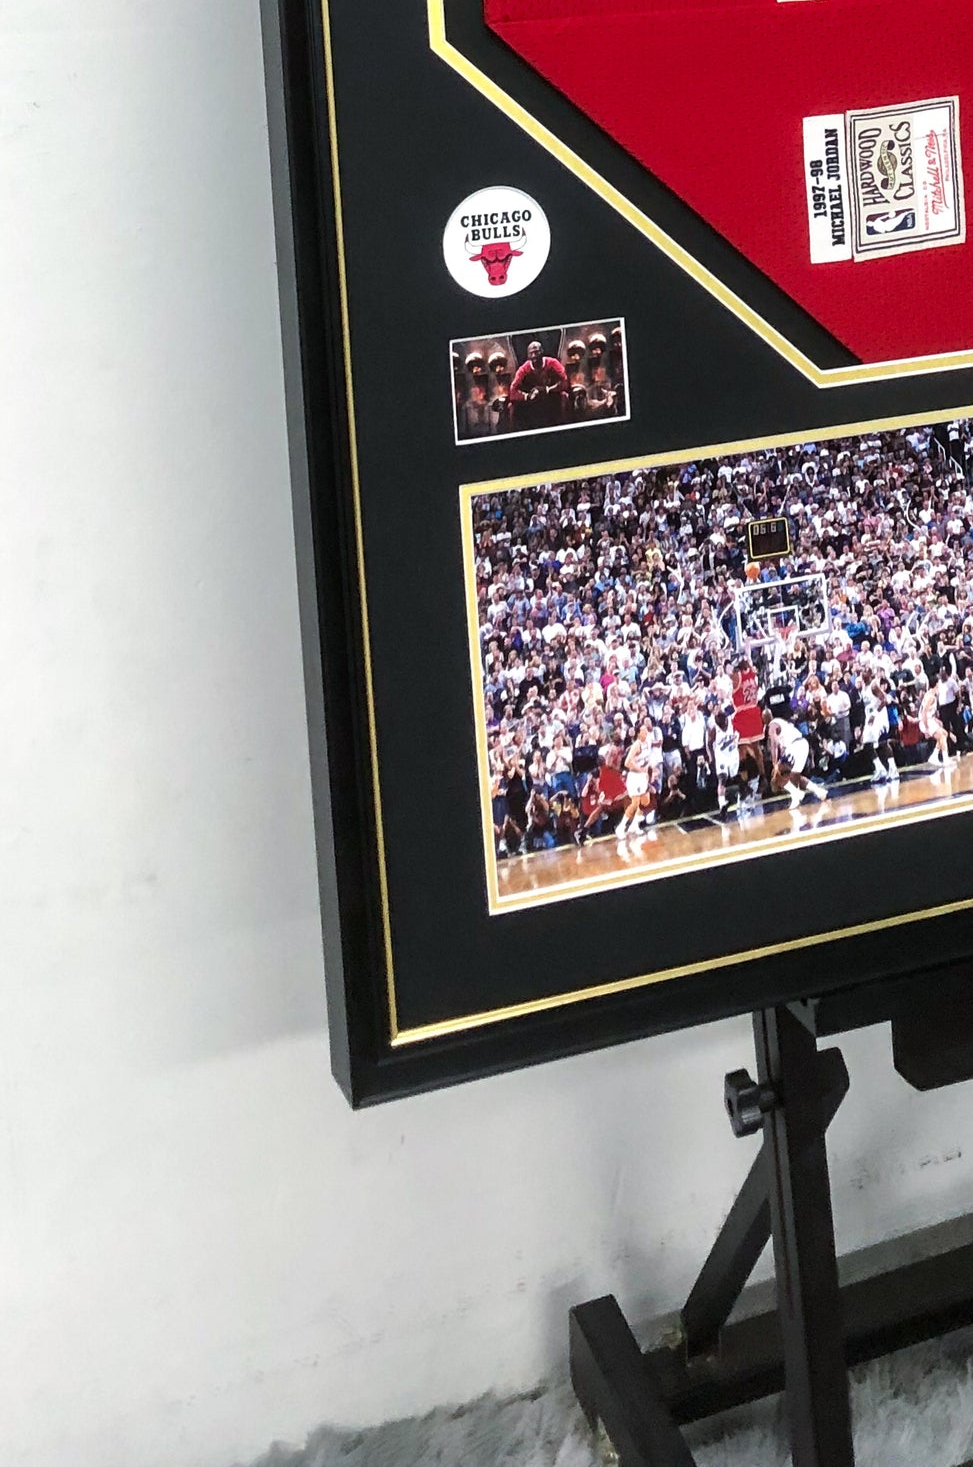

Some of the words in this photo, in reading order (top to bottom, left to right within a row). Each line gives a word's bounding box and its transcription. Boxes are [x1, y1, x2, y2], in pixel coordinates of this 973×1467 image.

[824, 128, 843, 182] JORDAN
[858, 127, 890, 207] HARDWOOD
[889, 121, 915, 201] CLASSICS
[809, 159, 829, 219] 1997-98
[828, 185, 846, 247] MICHAEL
[927, 166, 944, 215] Mitchell
[460, 209, 532, 229] CHICAGO
[471, 224, 521, 241] BULLS
